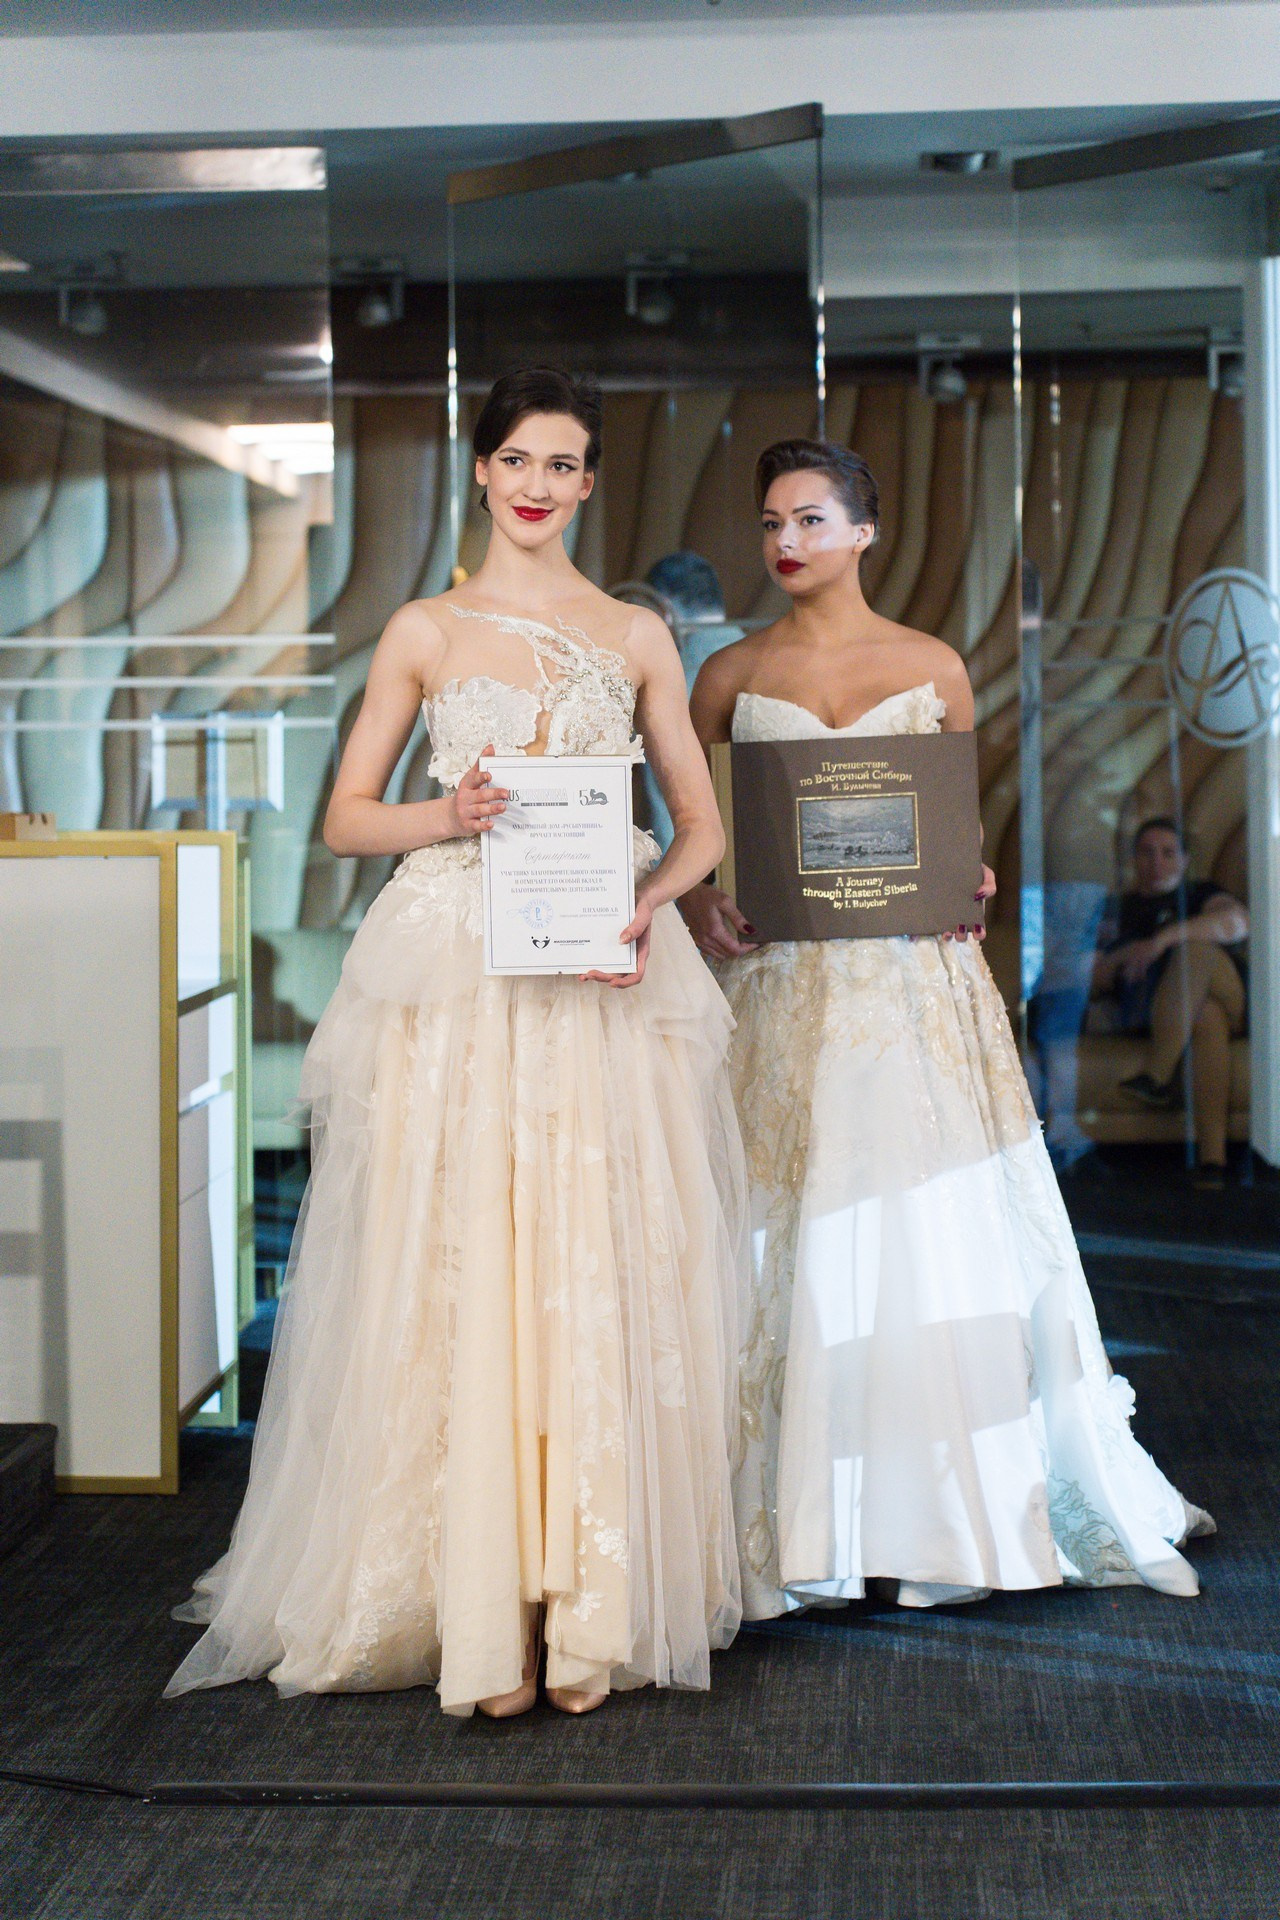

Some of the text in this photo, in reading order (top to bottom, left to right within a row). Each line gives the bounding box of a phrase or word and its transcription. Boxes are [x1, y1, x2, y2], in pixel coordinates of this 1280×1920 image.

[821, 761, 889, 773] Путешествие
[800, 769, 912, 787] по Восточной Сибири
[835, 876, 884, 887] A Journey
[802, 882, 918, 900] through Eastern Siberia
[833, 900, 843, 910] by
[852, 898, 888, 909] Bulychev
